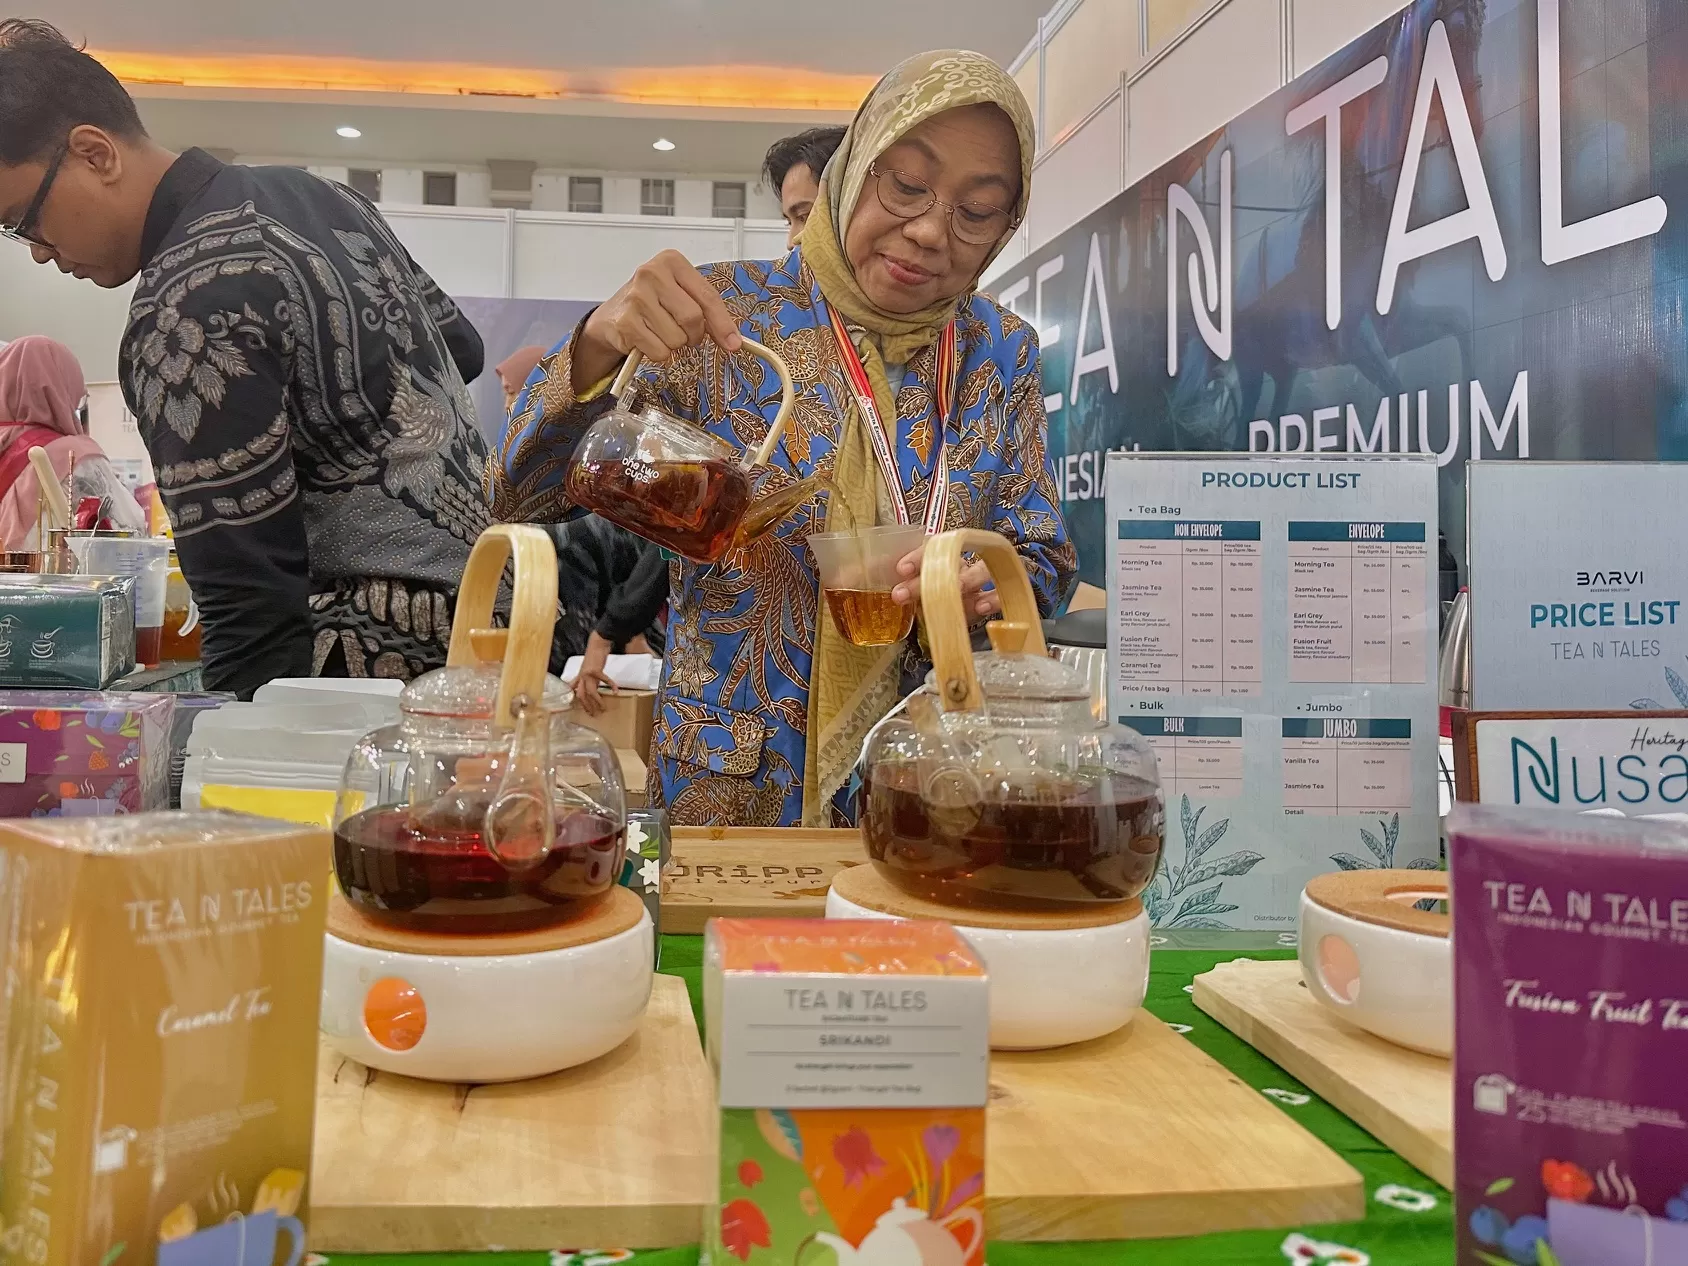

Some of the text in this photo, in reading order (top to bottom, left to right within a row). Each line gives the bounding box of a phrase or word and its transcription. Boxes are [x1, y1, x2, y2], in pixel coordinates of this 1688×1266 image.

[1167, 150, 1232, 377] N
[640, 464, 660, 478] two
[1202, 472, 1360, 488] PRODUCT LIST
[1138, 506, 1181, 515] Tea Bag
[1174, 524, 1222, 537] NON ENVELOPE
[1349, 524, 1384, 538] ENVELOPE
[1576, 571, 1644, 586] BARVI
[1530, 601, 1680, 628] PRICE LIST
[1550, 639, 1660, 660] TEA N TALES
[1140, 702, 1164, 710] Bulk
[1164, 718, 1184, 732] BULK
[1323, 719, 1357, 738] JUMBO
[1511, 736, 1688, 804] Nusa
[124, 898, 187, 931] TEA
[202, 894, 220, 922] N
[232, 880, 312, 916] TALES
[1482, 880, 1688, 931] TEA N TALE
[784, 989, 928, 1012] TEA N TALES
[1502, 979, 1582, 1014] Fusion
[1588, 991, 1653, 1026] Fruit
[157, 994, 240, 1038] Caramel
[819, 1034, 892, 1046] SRIKANDI
